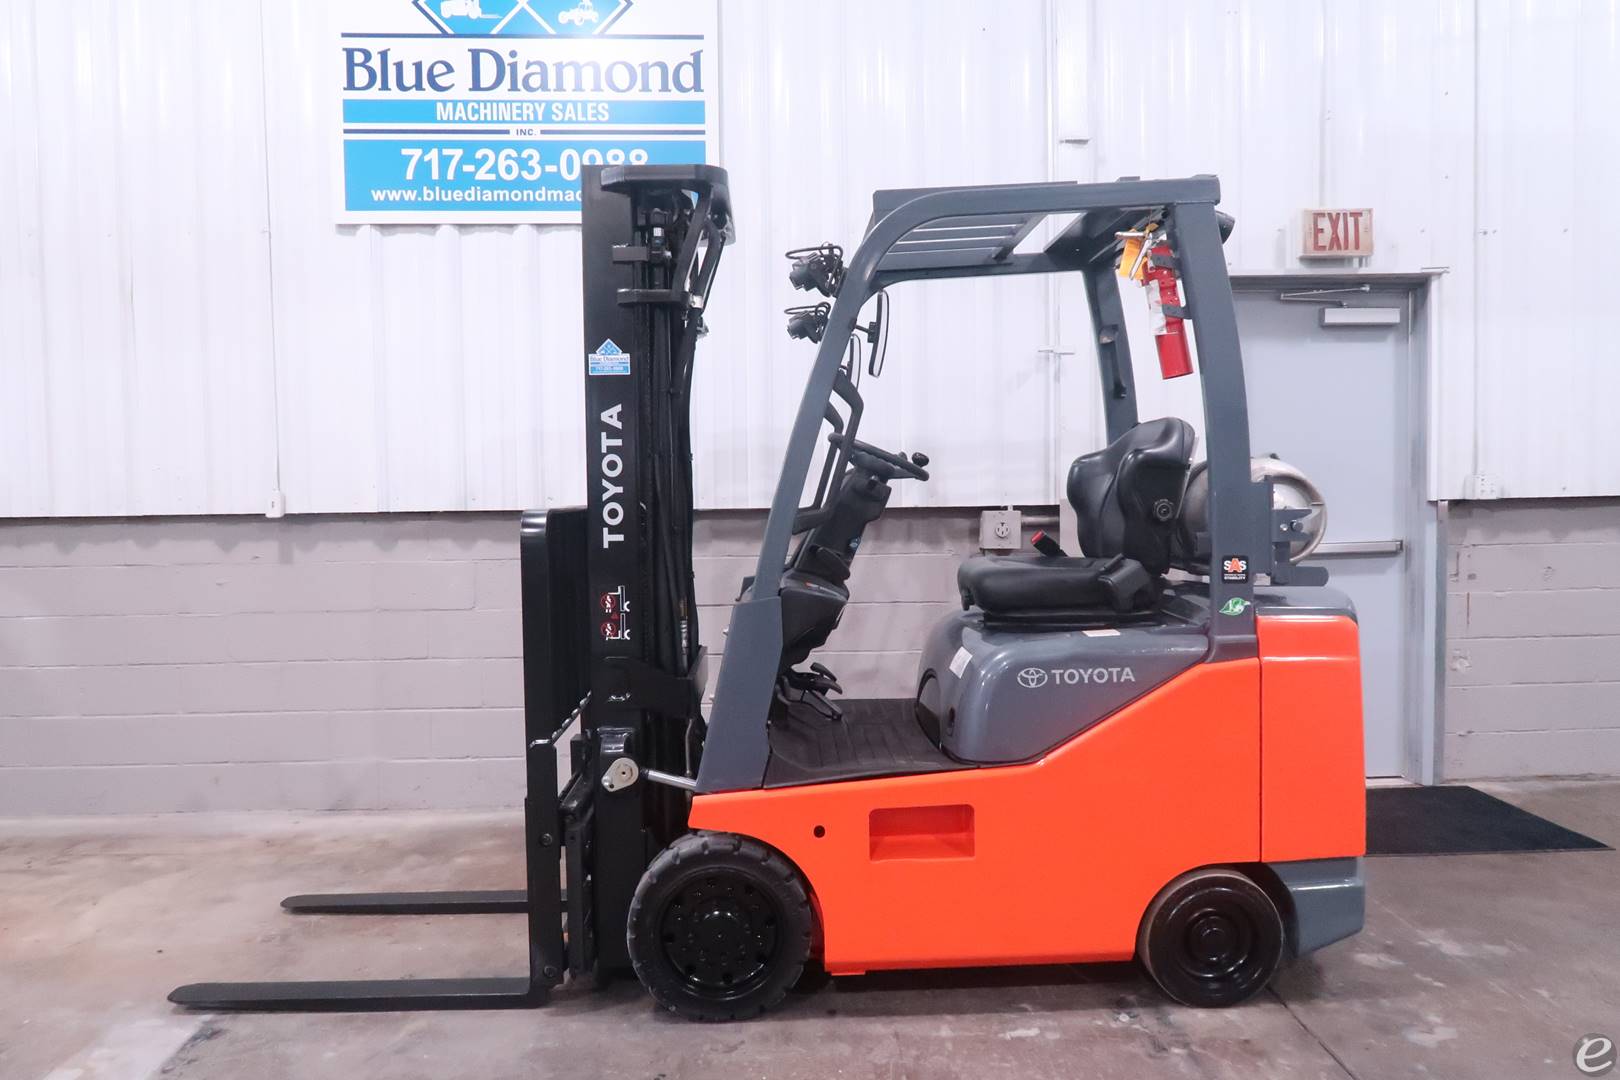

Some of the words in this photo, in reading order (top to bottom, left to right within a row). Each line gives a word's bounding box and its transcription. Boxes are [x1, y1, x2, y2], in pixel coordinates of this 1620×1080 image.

[342, 47, 456, 92] Blue
[467, 48, 705, 93] Diamond
[436, 102, 545, 121] MACHINERY
[551, 102, 610, 121] SALES
[516, 128, 537, 136] INC.
[1312, 212, 1363, 251] EXIT
[600, 403, 625, 549] TOYOTA
[1223, 558, 1247, 573] SAS
[1051, 667, 1136, 685] TOYOTA
